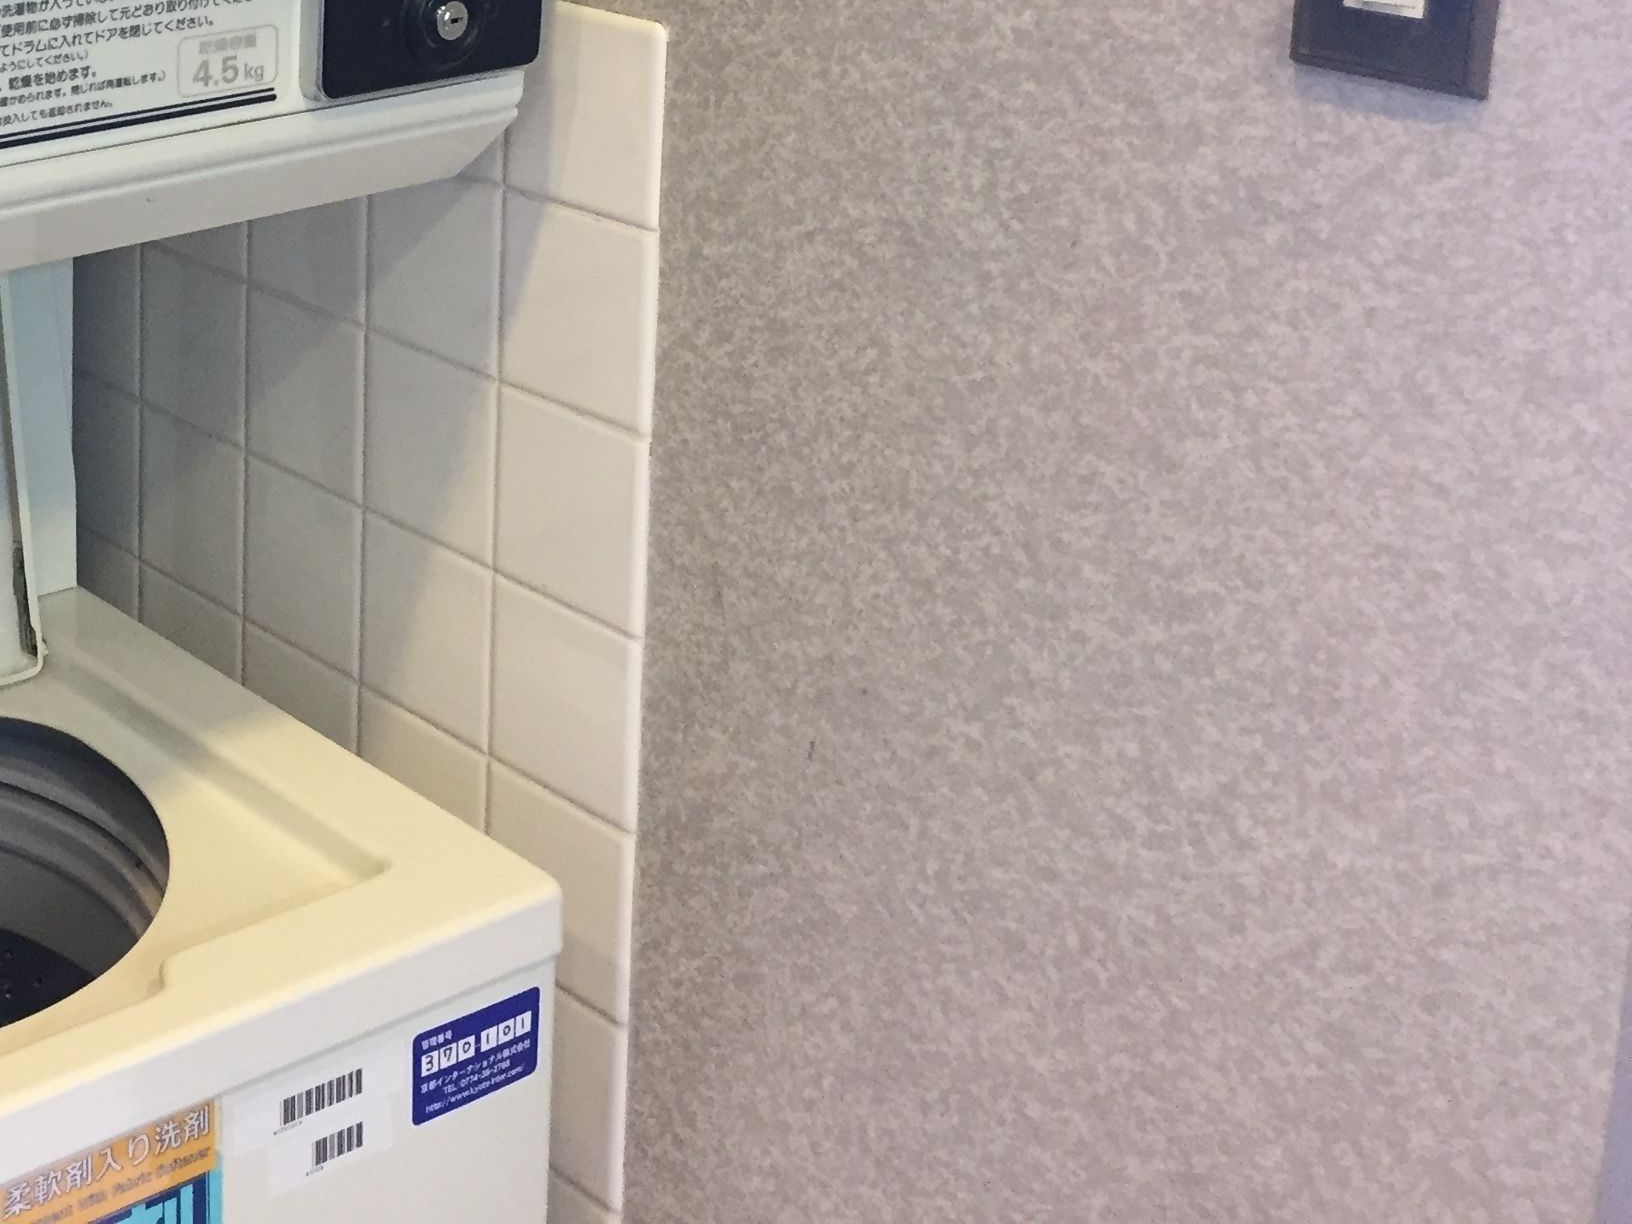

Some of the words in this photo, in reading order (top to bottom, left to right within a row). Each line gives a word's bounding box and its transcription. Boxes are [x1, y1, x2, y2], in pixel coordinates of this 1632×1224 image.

[421, 1039, 530, 1094] 京都インターナショナル株式会社
[422, 1030, 453, 1050] 管理番号
[2, 1105, 210, 1220] 柔軟剤入り洗剤
